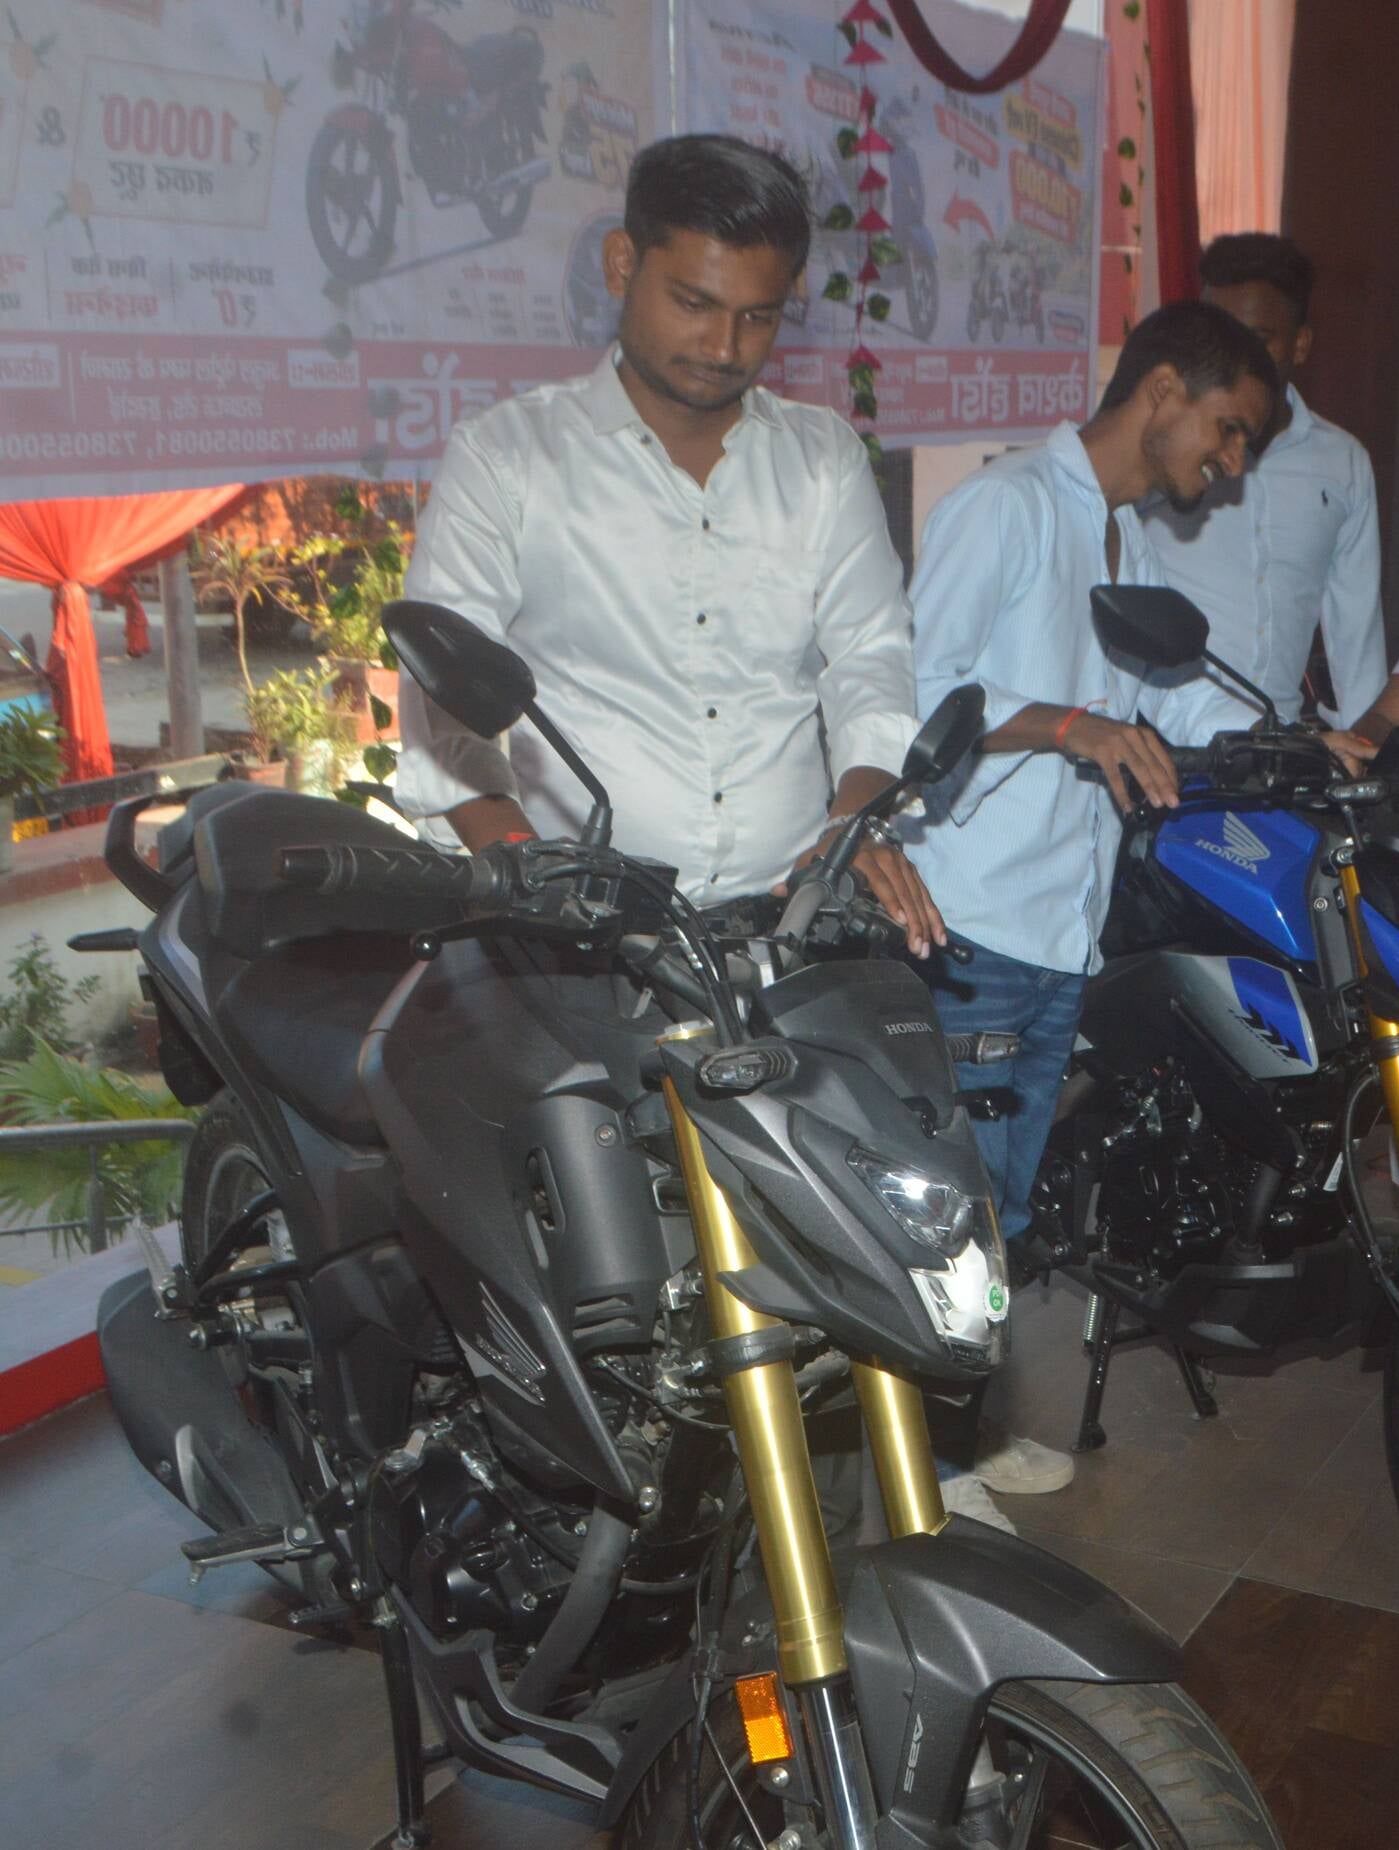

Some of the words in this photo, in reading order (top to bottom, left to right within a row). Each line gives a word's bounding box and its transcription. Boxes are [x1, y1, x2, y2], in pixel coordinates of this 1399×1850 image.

[1194, 839, 1258, 876] HONDA
[884, 1022, 934, 1036] HONDA
[903, 1712, 924, 1794] ABS
